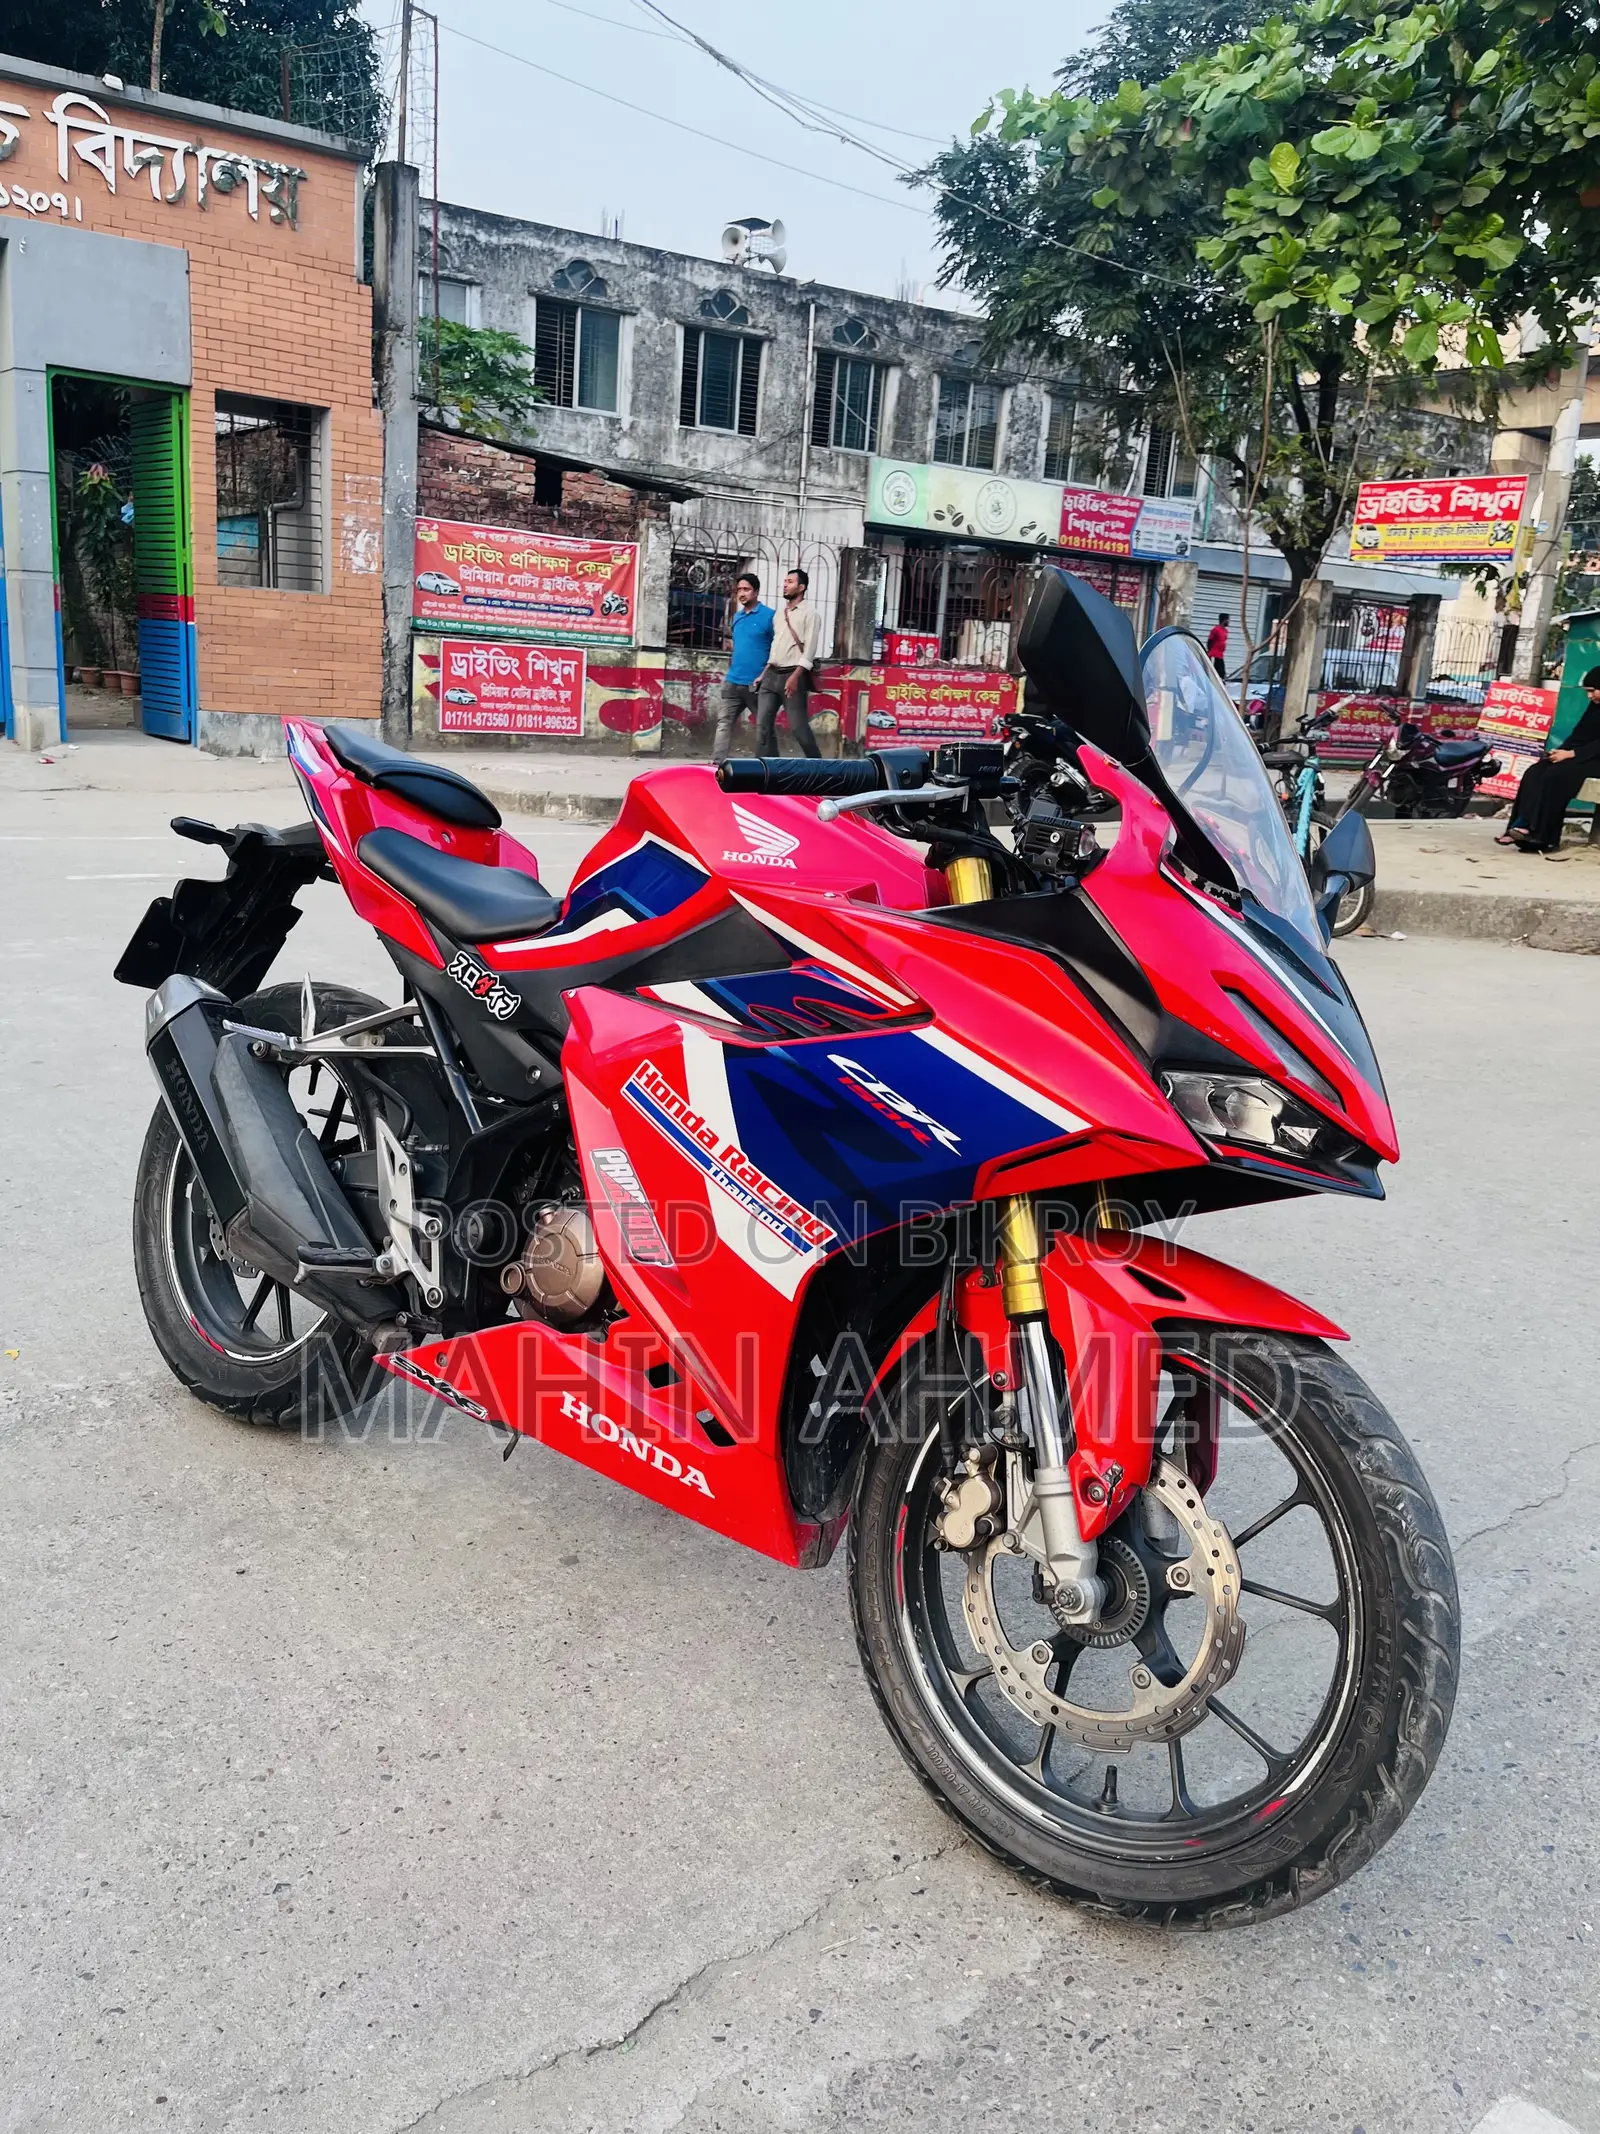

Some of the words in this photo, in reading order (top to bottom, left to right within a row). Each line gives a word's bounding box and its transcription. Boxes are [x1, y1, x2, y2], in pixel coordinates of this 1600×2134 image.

[43, 91, 308, 231] বিদ্যালয়
[1063, 493, 1108, 515] ড্রাইভিং
[1357, 487, 1442, 520] ড্রাইভিং
[1449, 485, 1524, 518] শিখুন
[1067, 512, 1106, 538] শিখুন
[443, 541, 505, 568] ড্রাইভিং
[509, 549, 572, 573] প্রশিক্ষণ
[576, 561, 615, 580] কেন্দ্র
[508, 572, 540, 588] মোটর
[542, 574, 580, 593] ড্রাইভিং
[582, 581, 604, 597] স্কুল
[450, 646, 522, 680] ড্রাইভিং
[525, 650, 579, 687] শিখুন
[886, 682, 927, 702] ড্রাইভিং
[930, 684, 971, 702] প্রশিক্ষণ
[975, 689, 1001, 704] কেন্দ্র
[1489, 688, 1544, 708] ড্রাইভিং
[445, 710, 509, 727] 01711-873560
[1506, 705, 1551, 729] শিখুন
[722, 850, 797, 869] HONDA
[165, 1057, 209, 1153] HONDA
[827, 1054, 962, 1157] CBR
[633, 1062, 719, 1150] Honda
[719, 1144, 836, 1245] Racing
[708, 1162, 788, 1234] Thailand
[559, 1391, 715, 1499] HONDA
[925, 1744, 971, 1796] 100/80-17
[966, 1793, 991, 1819] M/C
